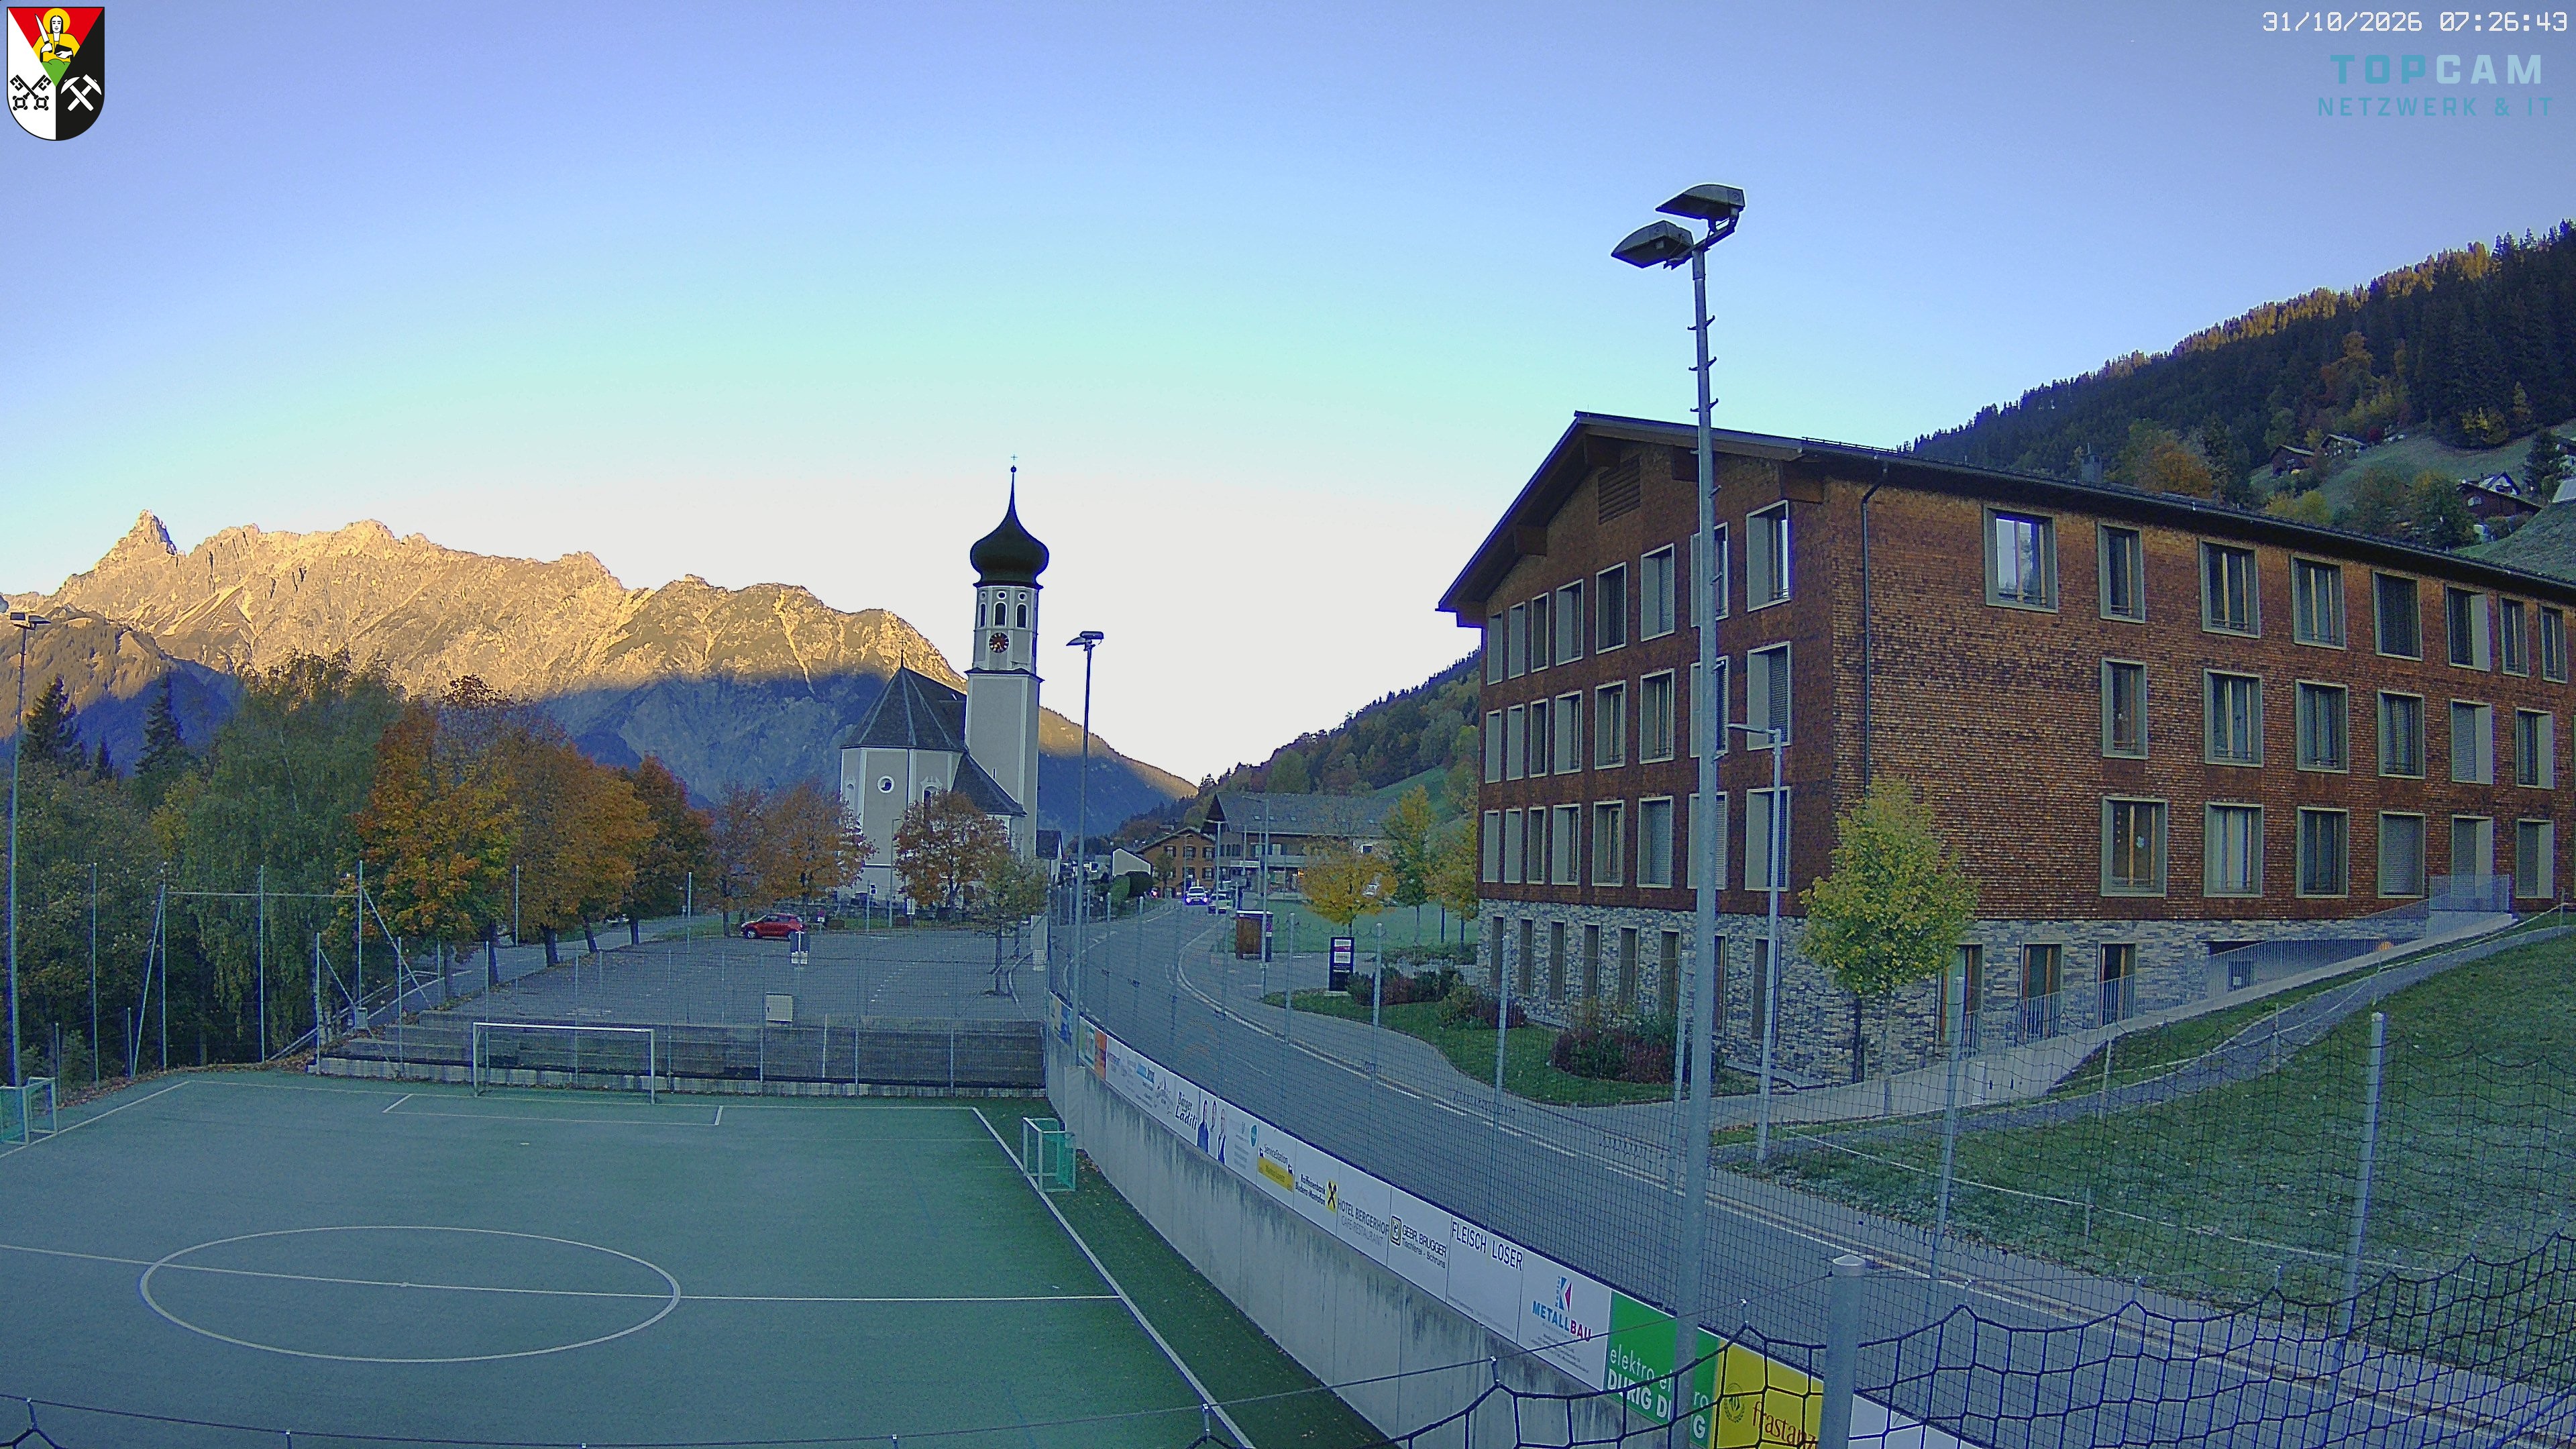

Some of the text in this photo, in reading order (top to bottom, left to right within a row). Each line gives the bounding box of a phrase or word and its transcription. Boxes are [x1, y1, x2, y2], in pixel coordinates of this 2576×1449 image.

[1338, 1197, 1390, 1236] HOTEL BERGERHOF
[1402, 1224, 1447, 1258] GEBR. BRUGGER
[1452, 1221, 1523, 1271] FLEISCH LOSER
[1532, 1300, 1592, 1342] METALLBAU
[1611, 1344, 1654, 1382] elektro
